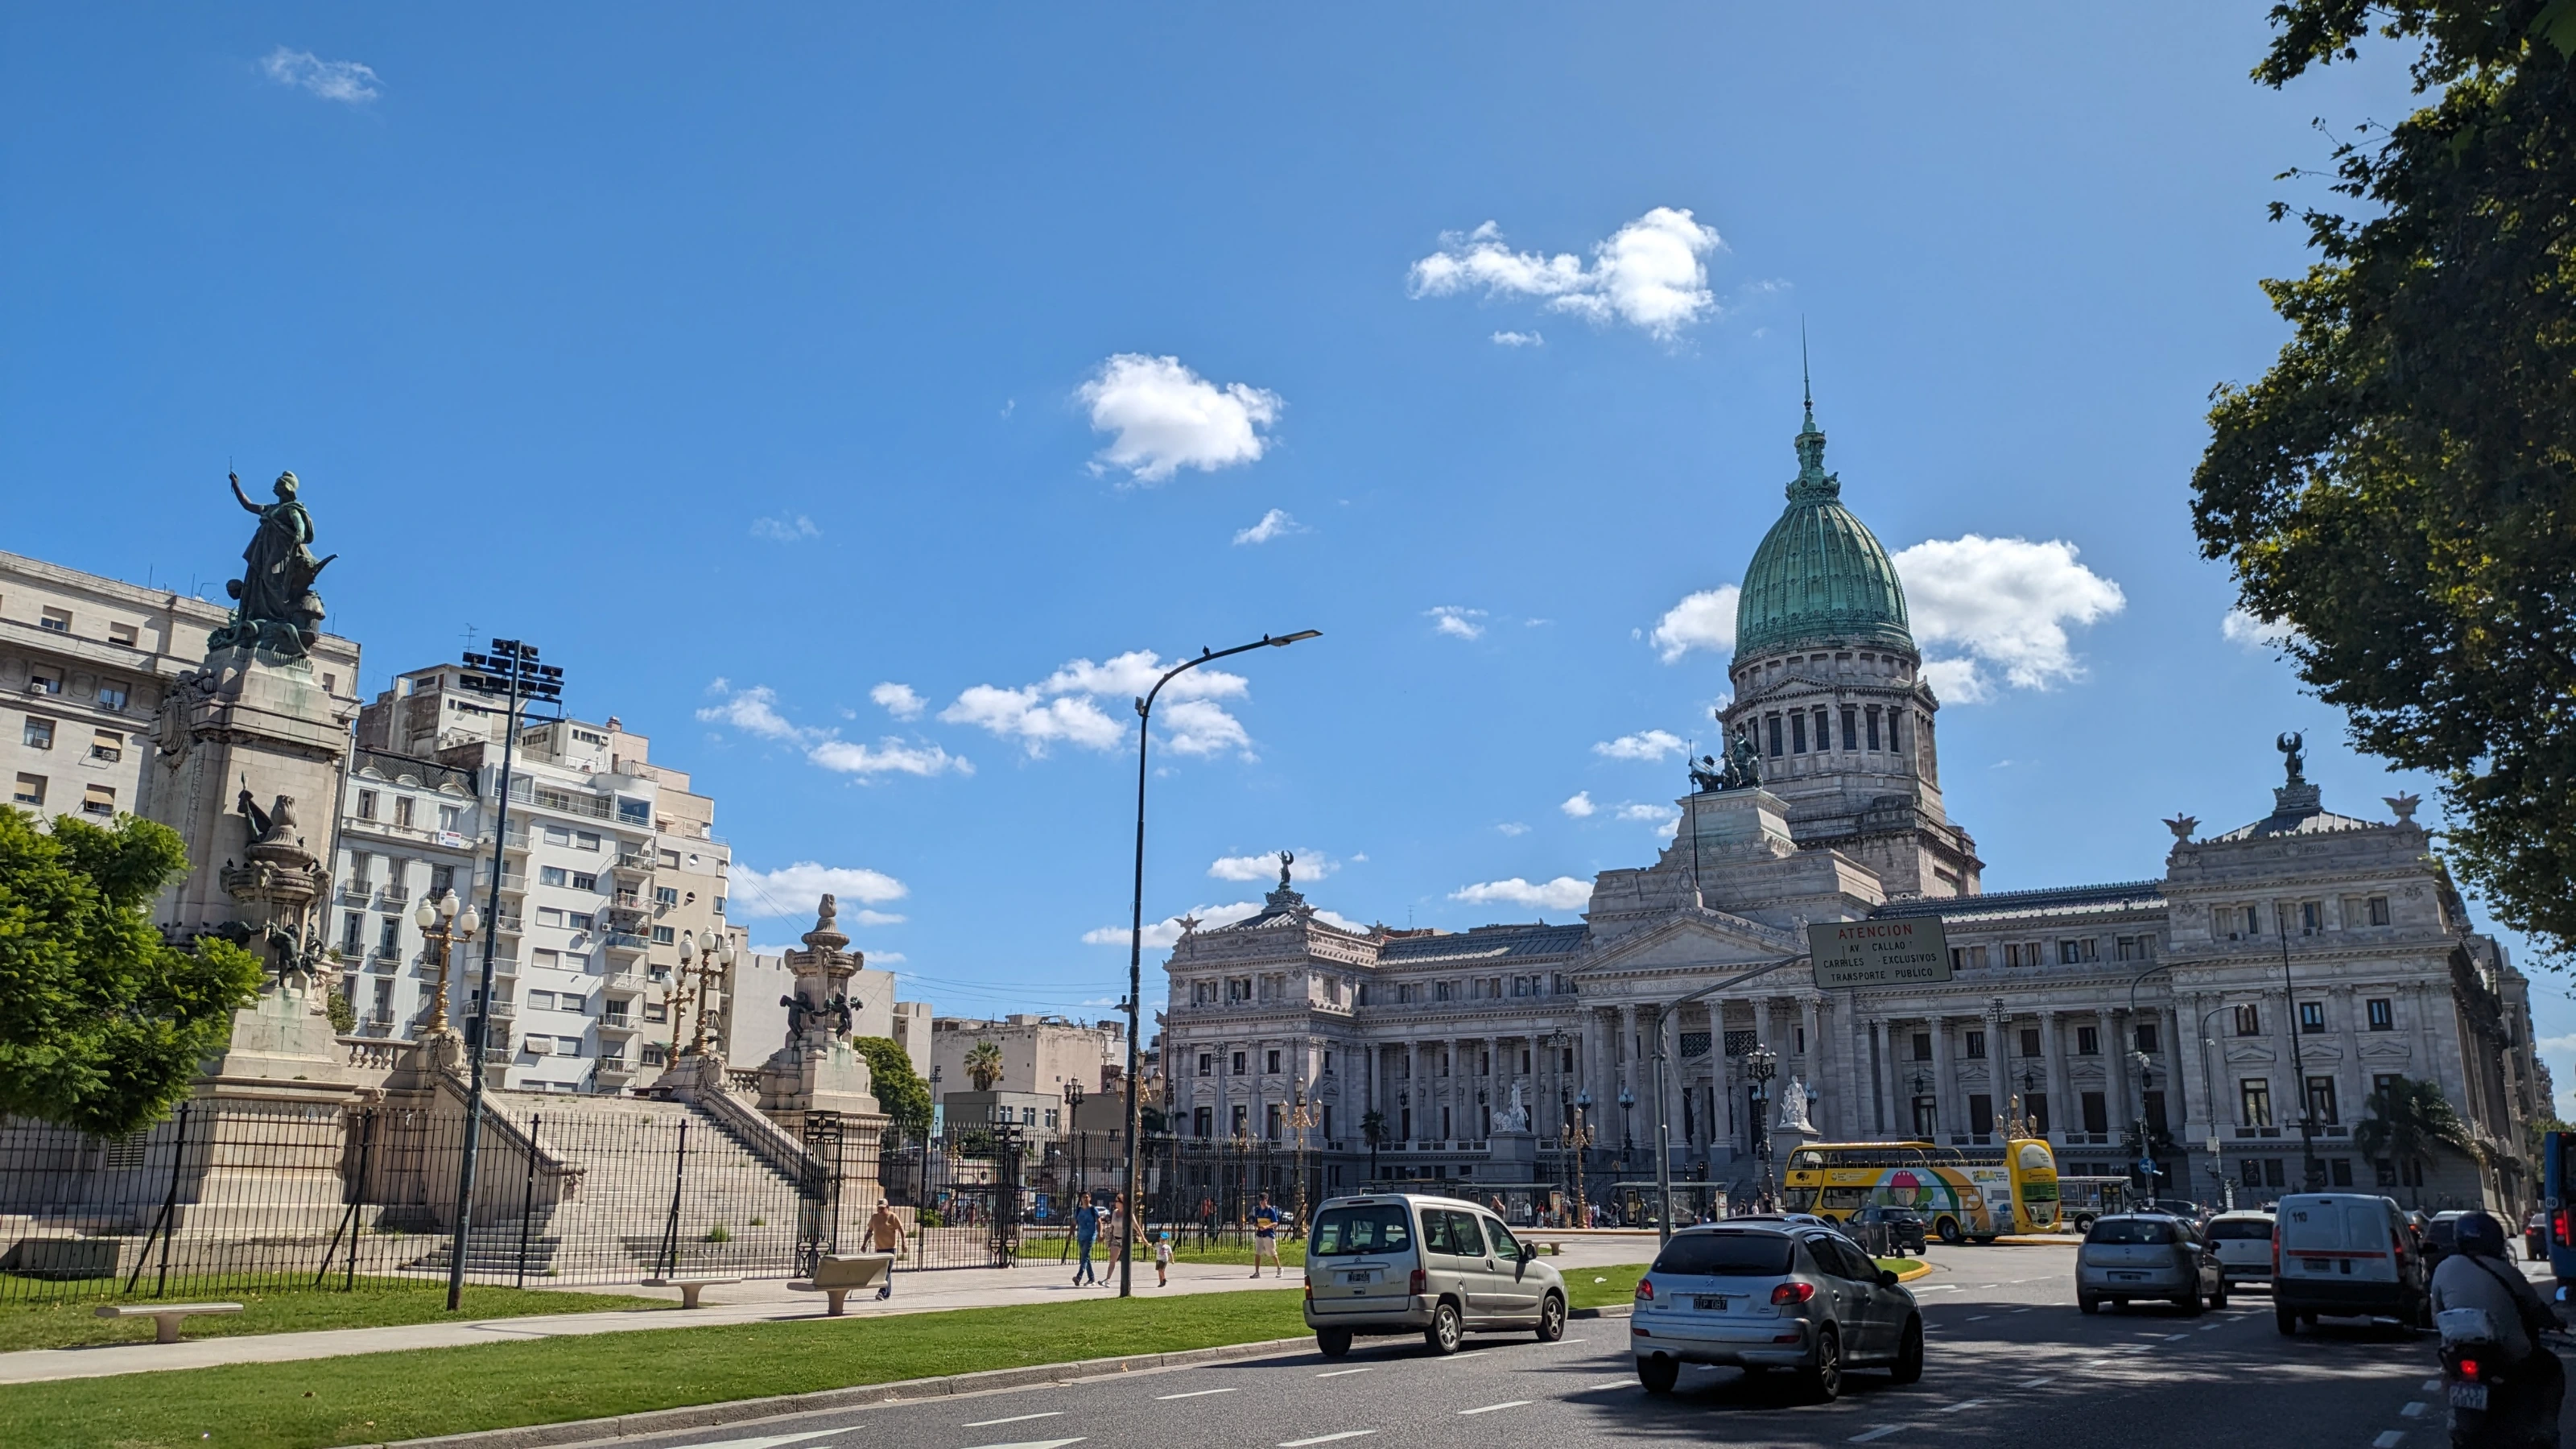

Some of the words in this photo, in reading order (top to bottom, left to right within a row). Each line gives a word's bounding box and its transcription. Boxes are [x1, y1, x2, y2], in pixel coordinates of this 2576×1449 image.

[1839, 924, 1912, 939] ATENCION
[1849, 944, 1861, 953] AV.
[1872, 941, 1905, 952] CALLAO
[1823, 957, 1864, 968] CARRILES
[1883, 953, 1937, 964] EXCLUSIVOS
[1831, 971, 1885, 982] TRANSPORTE
[1895, 968, 1933, 978] PUBLICO
[2292, 1212, 2307, 1223] 110
[1711, 1300, 1726, 1309] 087
